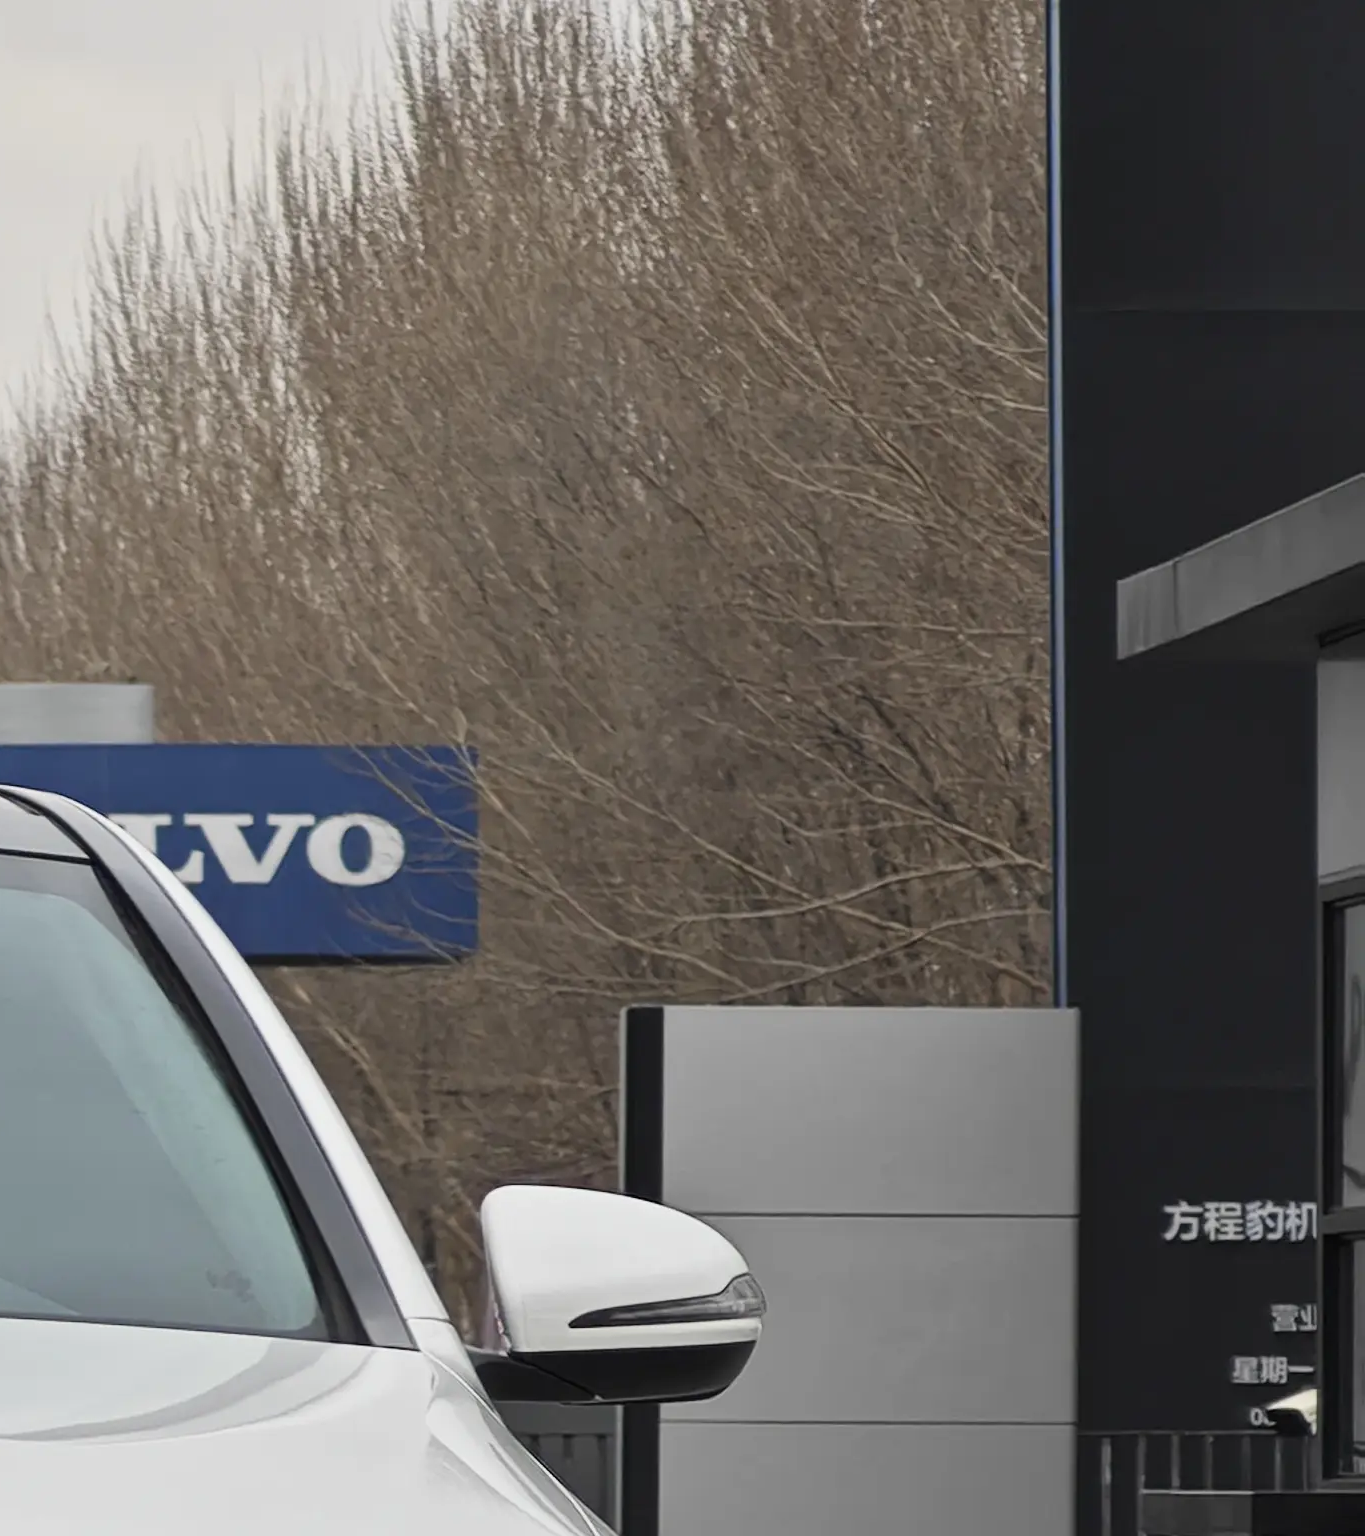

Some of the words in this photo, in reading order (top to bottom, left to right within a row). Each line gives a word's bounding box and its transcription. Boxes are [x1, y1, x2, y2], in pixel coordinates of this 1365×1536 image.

[1162, 1200, 1318, 1242] 方程豹机
[1231, 1355, 1315, 1385] 星期一
